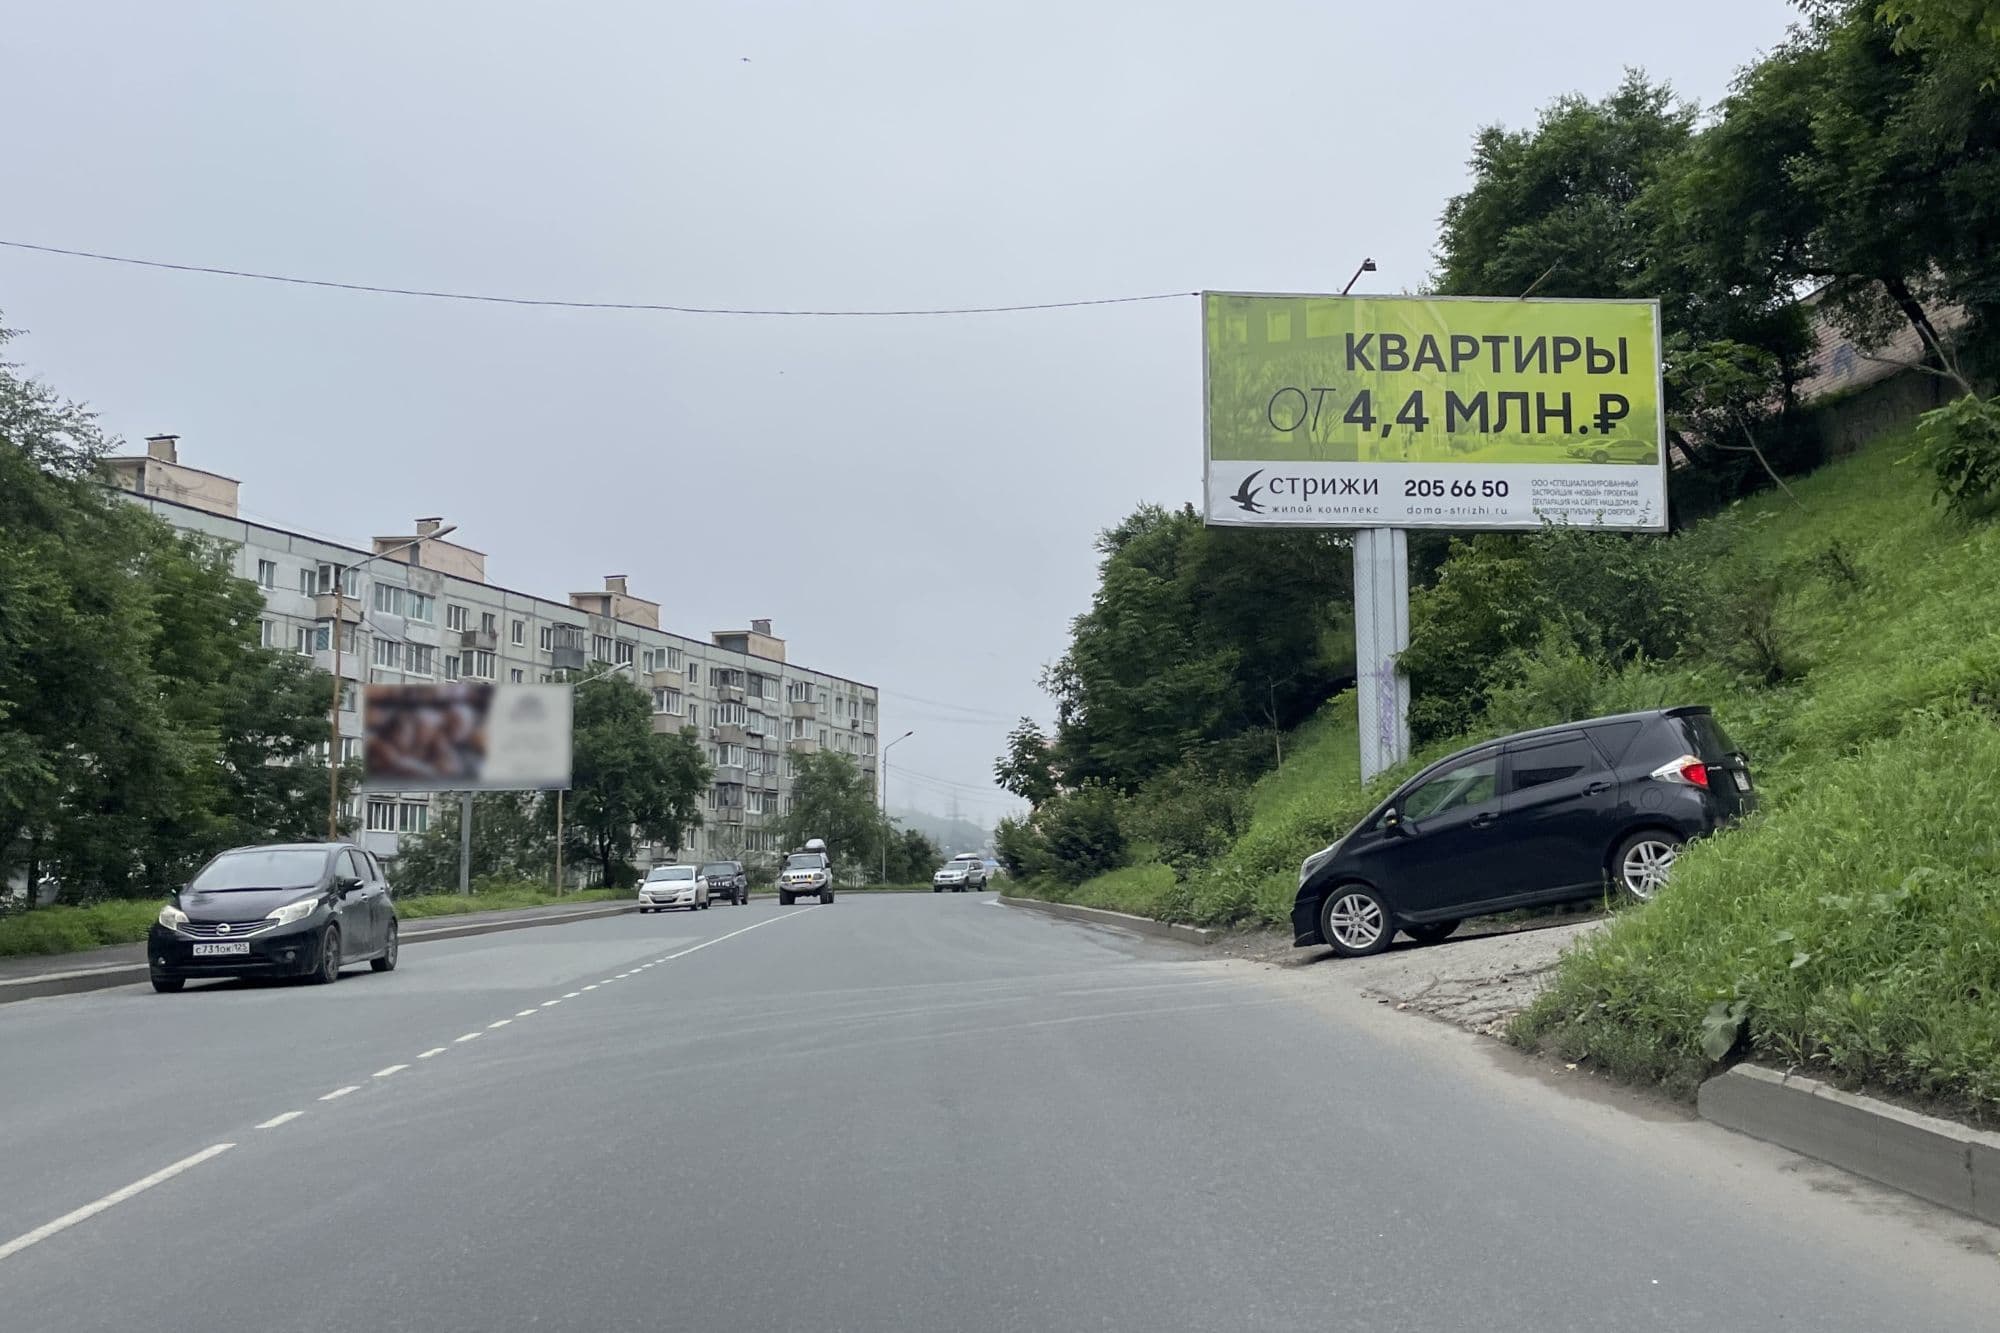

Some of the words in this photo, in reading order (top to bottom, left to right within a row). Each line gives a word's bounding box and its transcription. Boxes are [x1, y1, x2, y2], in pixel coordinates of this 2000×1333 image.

[1345, 332, 1628, 375] КВАРТИРЫ
[1268, 387, 1336, 432] ОТ
[1343, 389, 1430, 438] 4,4
[1269, 476, 1379, 501] стрижи
[1404, 479, 1445, 497] 205
[1450, 480, 1476, 497] 66
[1481, 480, 1509, 497] 50
[1531, 479, 1548, 487] ООО
[1272, 504, 1313, 514] жилой
[1318, 505, 1379, 514] комплекс
